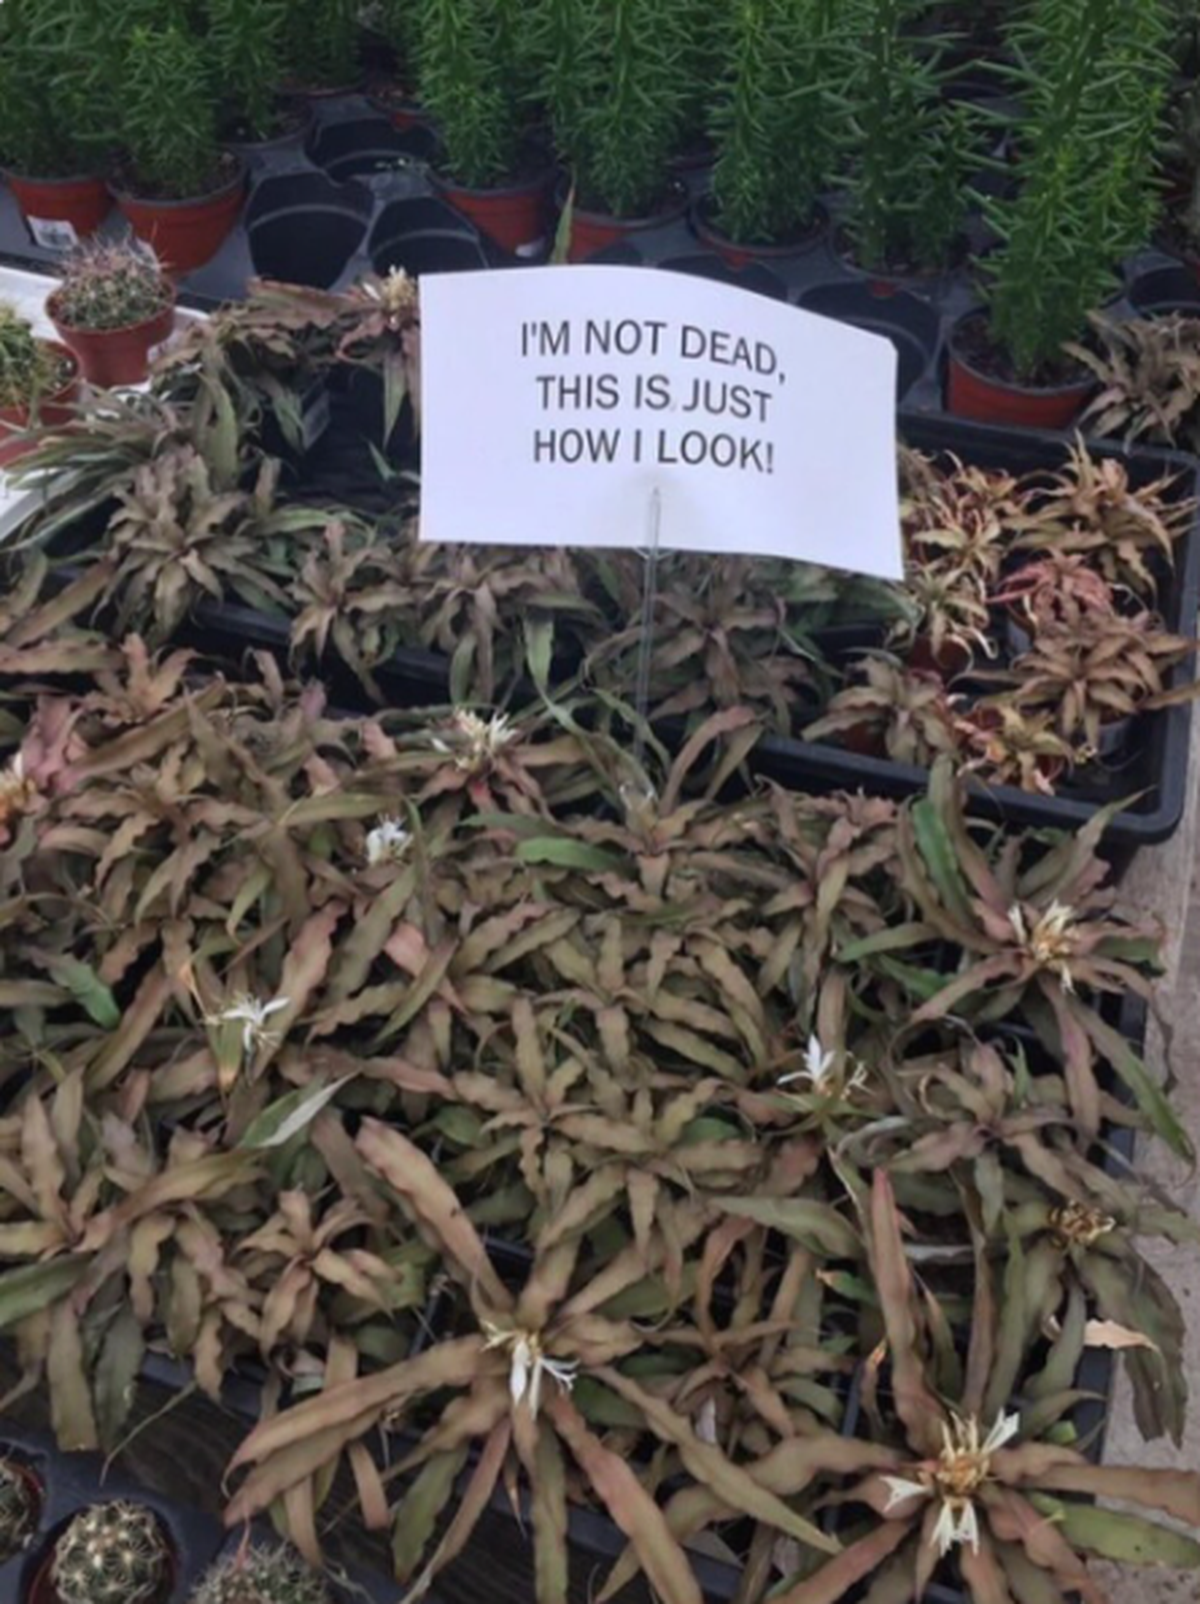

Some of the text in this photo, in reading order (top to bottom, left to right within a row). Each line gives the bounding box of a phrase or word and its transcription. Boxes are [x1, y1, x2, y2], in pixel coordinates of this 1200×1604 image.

[521, 319, 786, 385] I'M NOT DEAD,
[536, 374, 772, 422] THIS IS JUST
[534, 429, 774, 474] HOW I LOOK!
